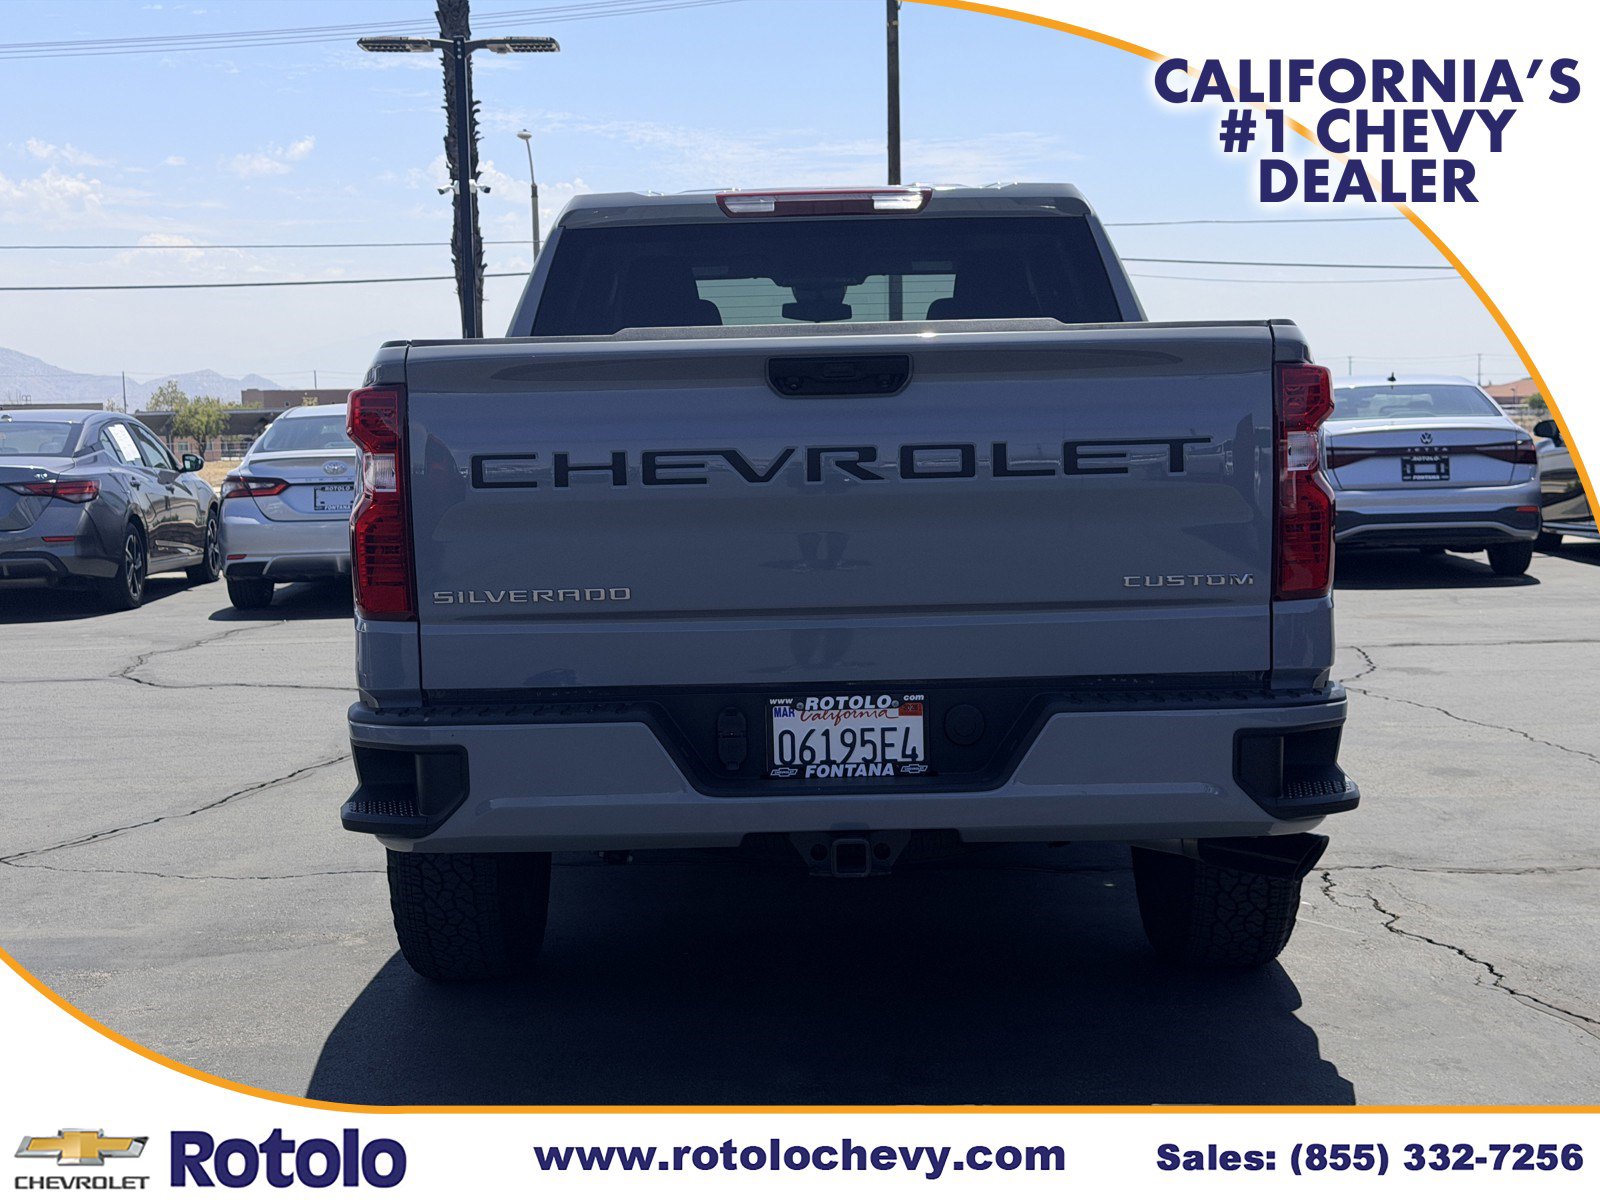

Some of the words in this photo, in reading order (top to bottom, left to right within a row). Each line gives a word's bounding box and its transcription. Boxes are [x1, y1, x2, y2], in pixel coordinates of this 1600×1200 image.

[470, 436, 1212, 489] CHEVROLET
[1123, 573, 1254, 587] CUSTOM
[433, 587, 632, 604] SILVERADO
[805, 694, 892, 710] ROTOLO
[774, 707, 795, 718] MAR
[801, 709, 899, 726] California
[778, 726, 919, 765] 06195E4
[804, 763, 895, 779] FONTANA
